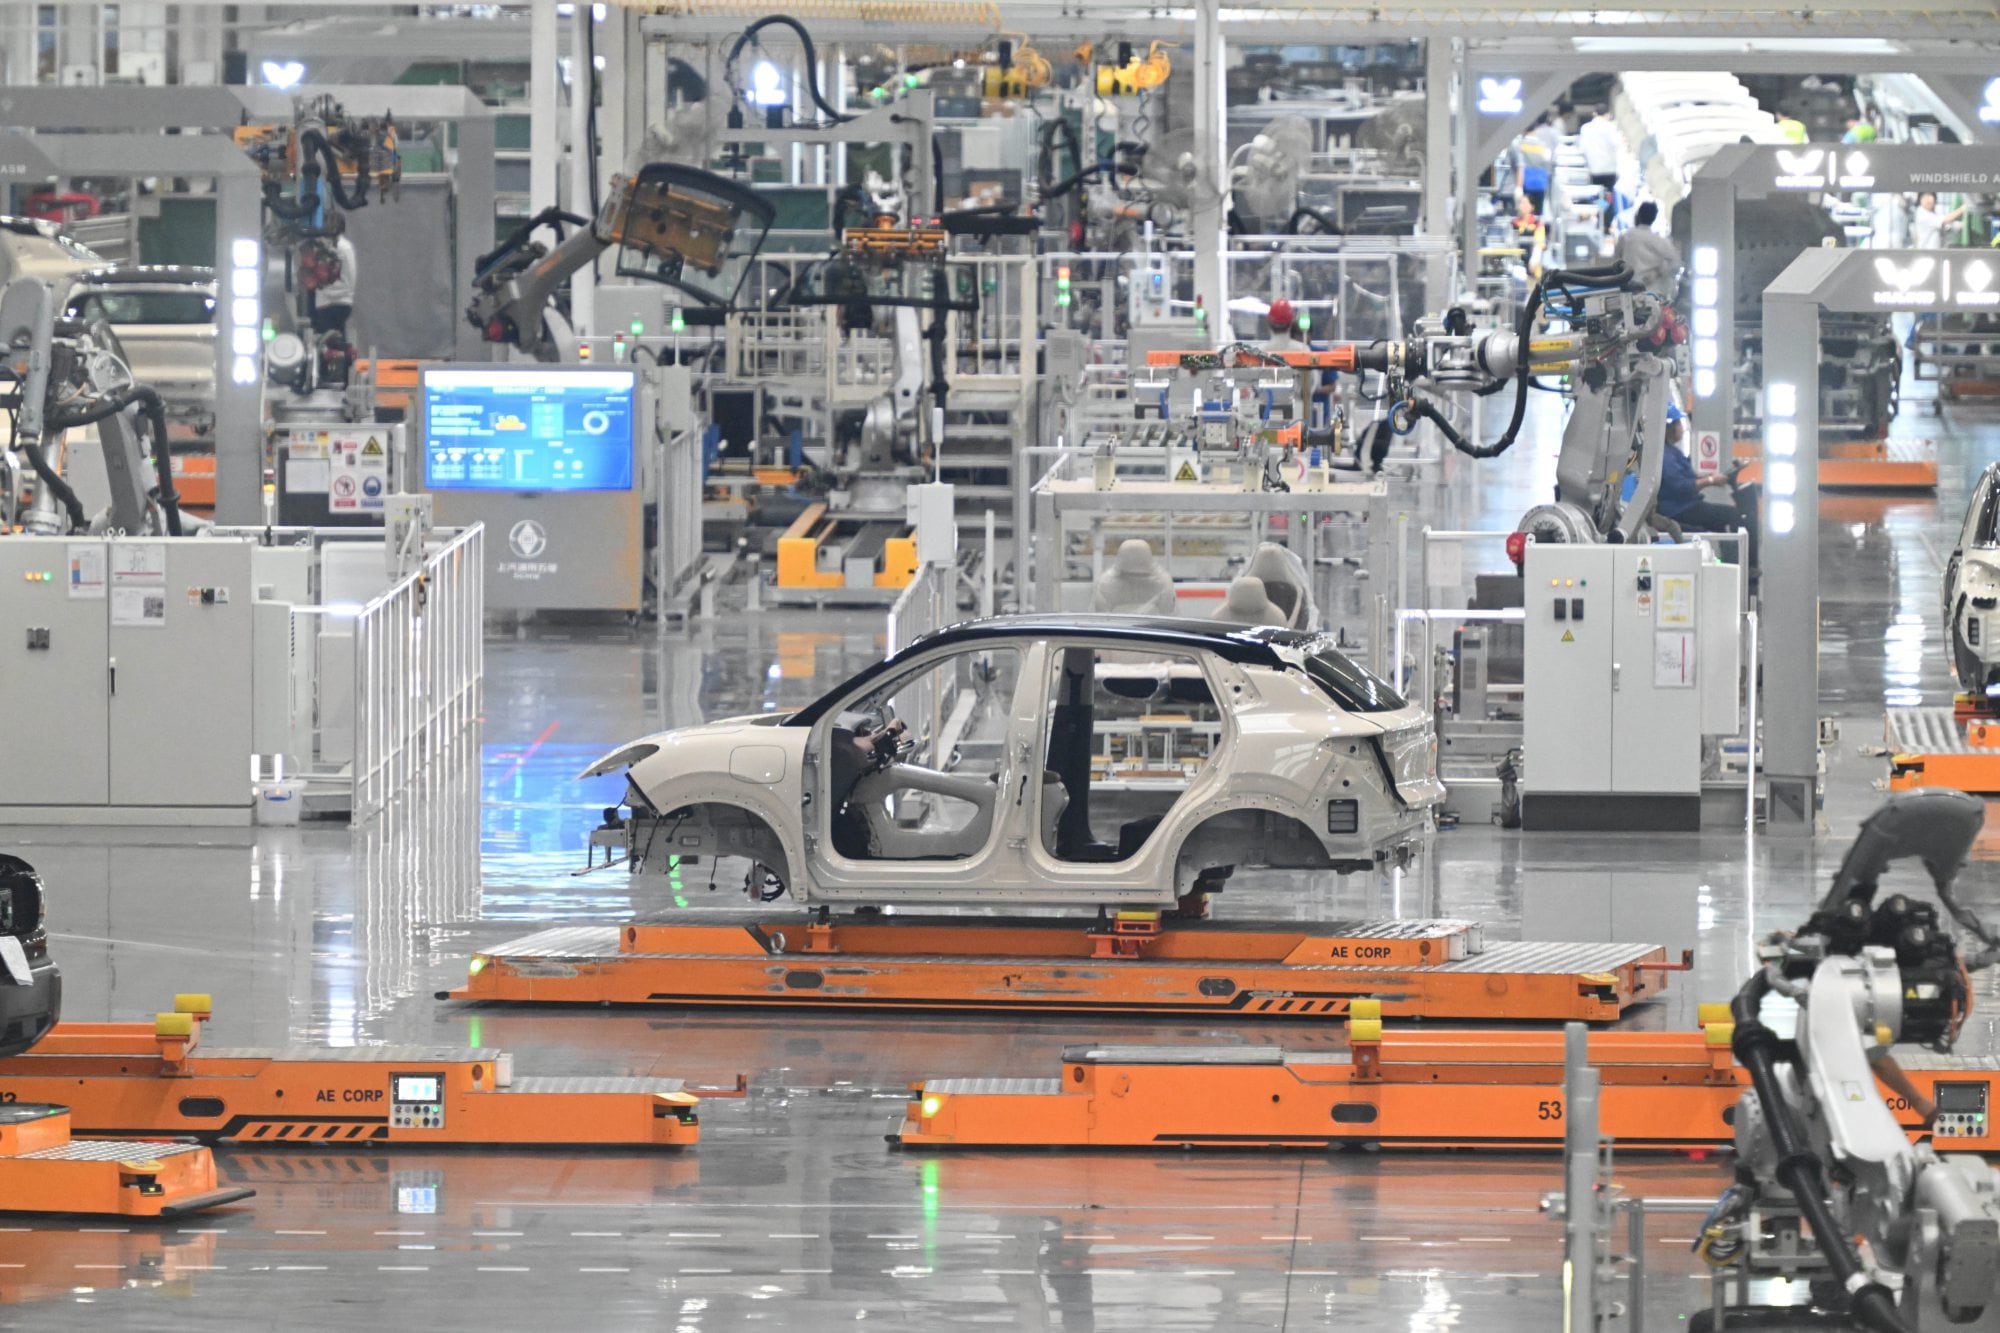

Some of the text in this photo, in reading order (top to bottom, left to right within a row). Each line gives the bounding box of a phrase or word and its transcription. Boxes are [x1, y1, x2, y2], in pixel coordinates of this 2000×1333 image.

[1910, 173, 1988, 183] WINDSHIELD
[1331, 946, 1348, 958] AE
[316, 1089, 335, 1102] AE
[1886, 1098, 1912, 1110] CO
[1538, 1101, 1562, 1120] 53
